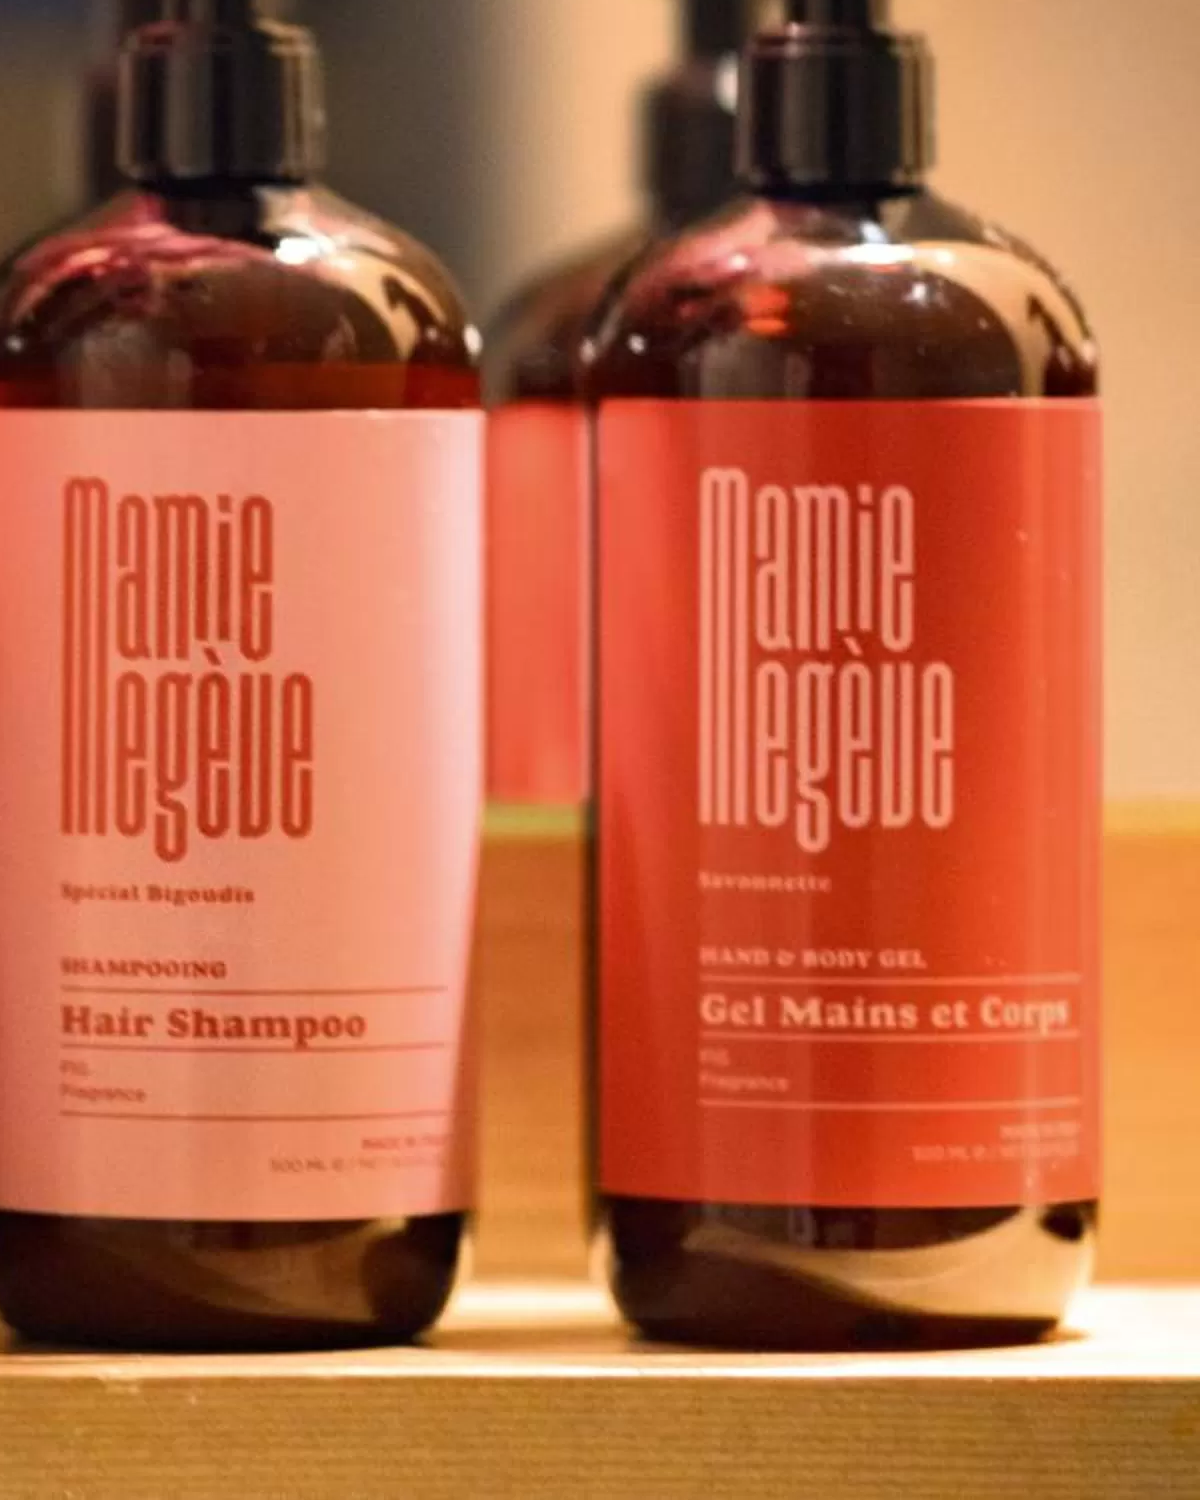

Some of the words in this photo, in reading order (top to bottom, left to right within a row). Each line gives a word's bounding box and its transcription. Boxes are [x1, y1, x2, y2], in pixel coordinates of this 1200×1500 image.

[64, 475, 274, 663] Mamie
[700, 466, 915, 653] Mamie
[60, 956, 228, 980] SHAMPOOING
[700, 947, 770, 967] HAND
[802, 949, 871, 969] BODY
[878, 949, 928, 969] GEL
[60, 1004, 154, 1038] Hair
[166, 1007, 368, 1049] Shampoo
[700, 992, 766, 1027] Gel
[778, 994, 919, 1029] Mains
[930, 997, 969, 1029] et
[979, 995, 1070, 1037] Corps
